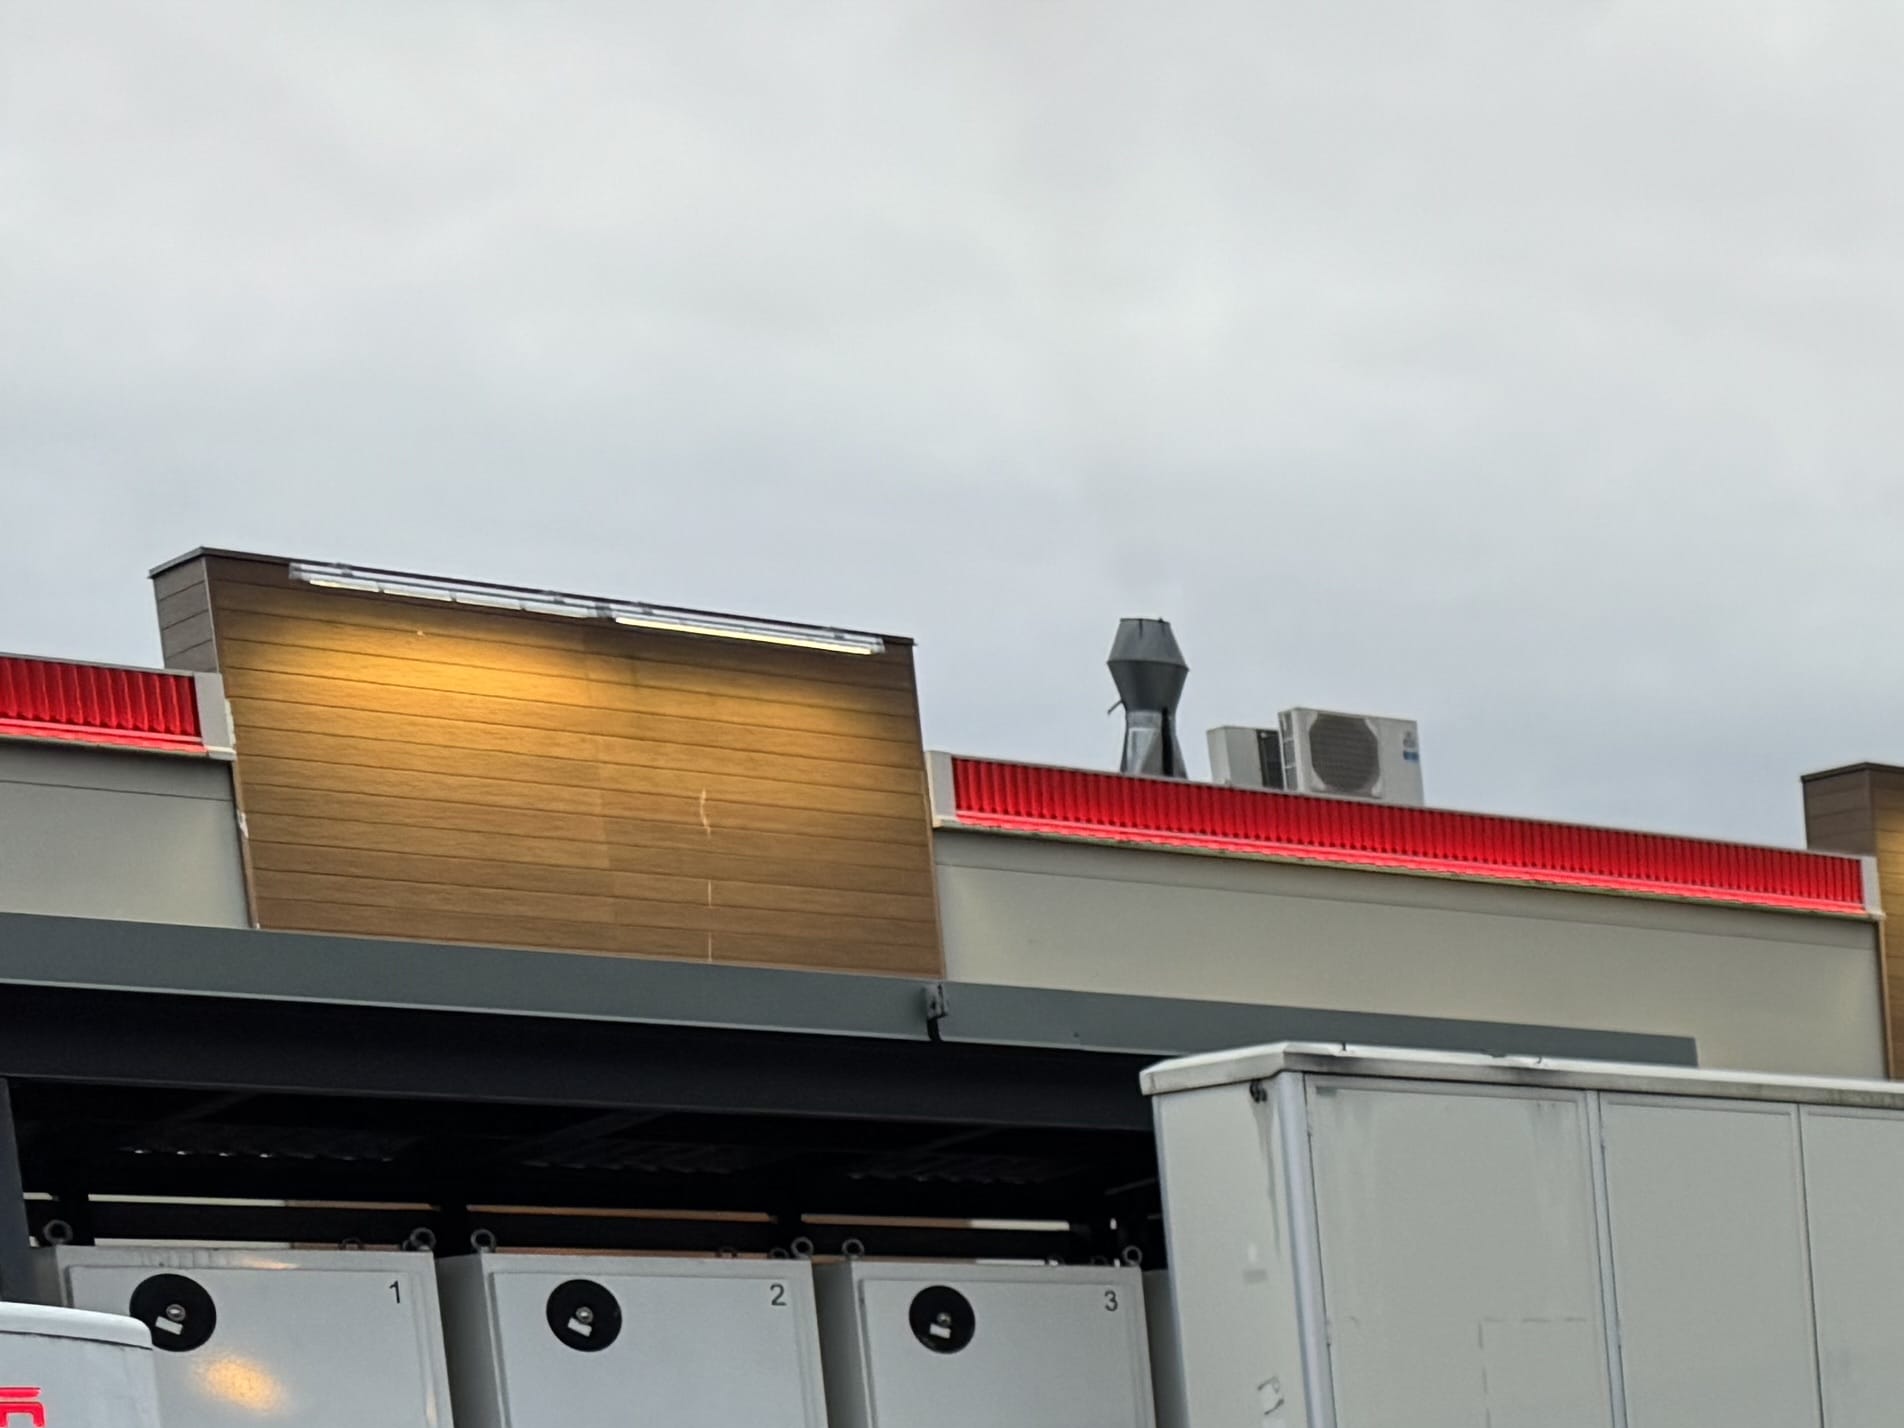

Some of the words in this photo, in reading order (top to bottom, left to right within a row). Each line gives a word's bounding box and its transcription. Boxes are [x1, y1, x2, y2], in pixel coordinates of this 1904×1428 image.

[389, 1280, 400, 1304] 1
[770, 1283, 787, 1306] 2
[1104, 1290, 1118, 1312] 3
